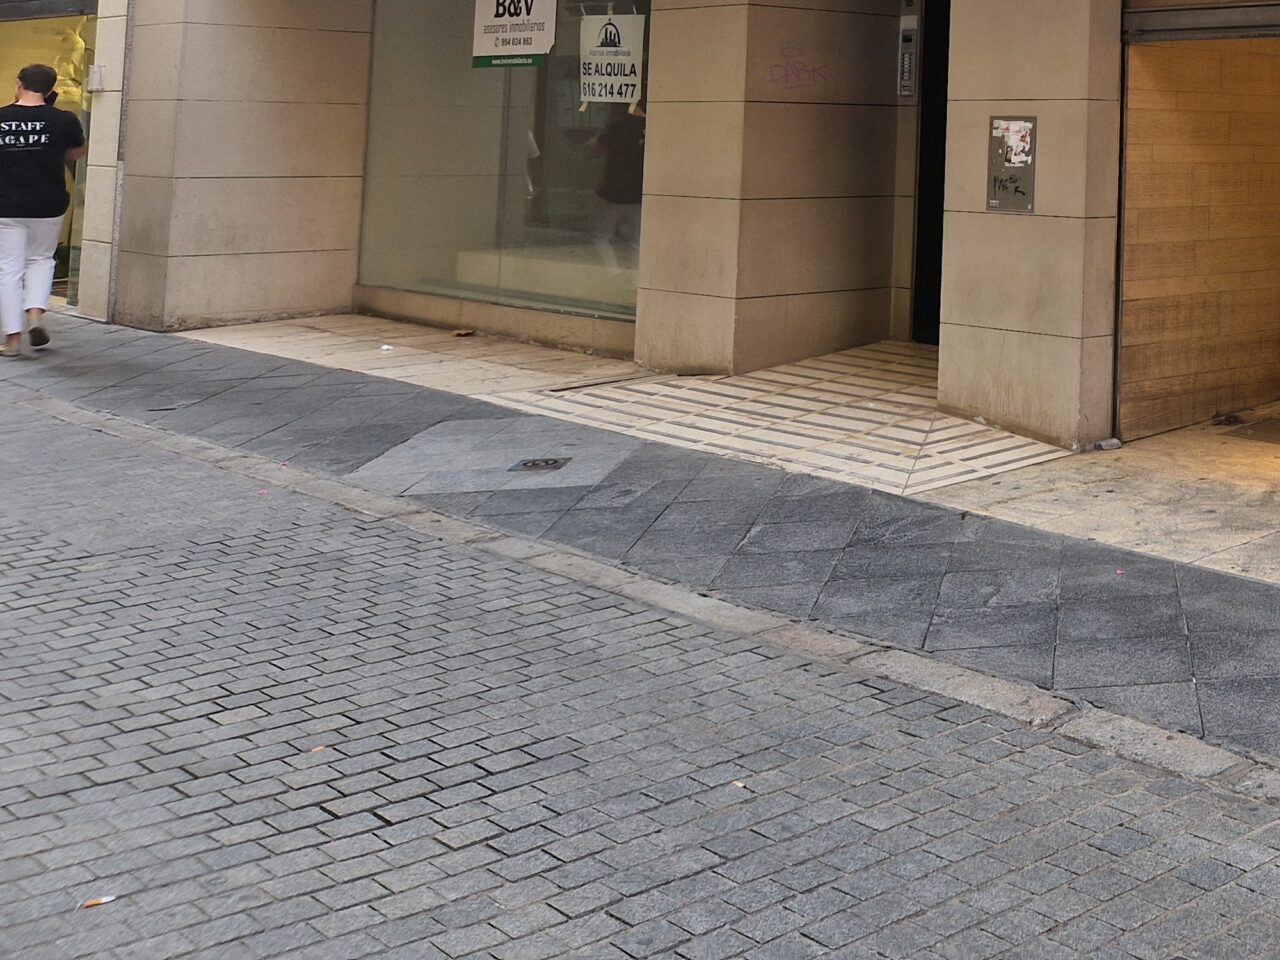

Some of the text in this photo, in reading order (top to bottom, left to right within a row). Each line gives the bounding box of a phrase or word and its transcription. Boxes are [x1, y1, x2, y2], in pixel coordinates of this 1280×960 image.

[483, 19, 545, 34] asesores inmobiliarios
[501, 38, 511, 46] 954
[582, 62, 637, 77] SE ALQUILA
[582, 82, 637, 99] 616 214 477
[1, 121, 46, 131] STAFF
